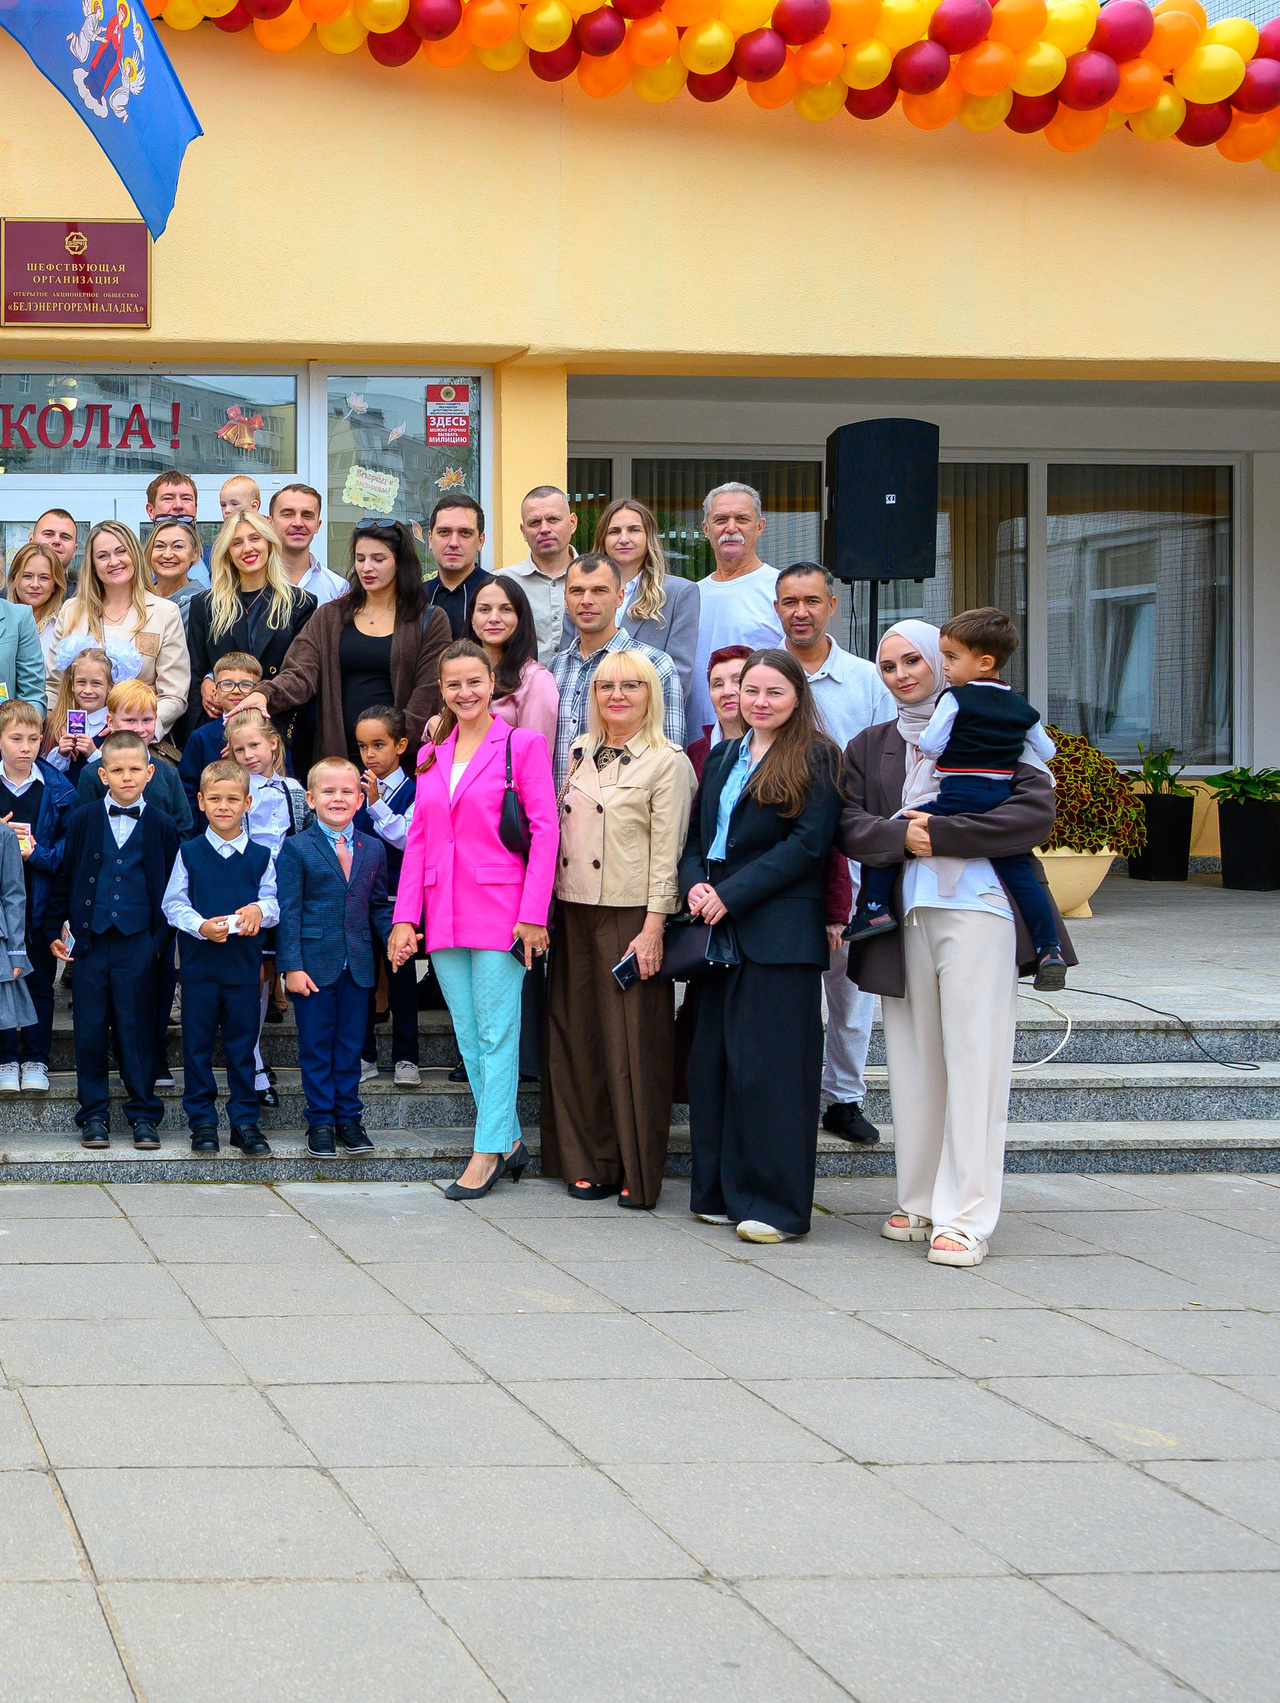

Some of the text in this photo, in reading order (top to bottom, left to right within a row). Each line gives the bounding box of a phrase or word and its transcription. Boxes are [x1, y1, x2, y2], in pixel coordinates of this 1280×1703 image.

[26, 263, 126, 273] ШЕФСТВУЮЩАЯ
[32, 275, 120, 285] ОРГАНИЗАЦИЯ
[7, 302, 145, 313] «БЕЛЭНЕРГОРЕМНАЛАДКА»
[429, 416, 467, 428] ЗДЕСЬ
[354, 480, 391, 494] знаниям!
